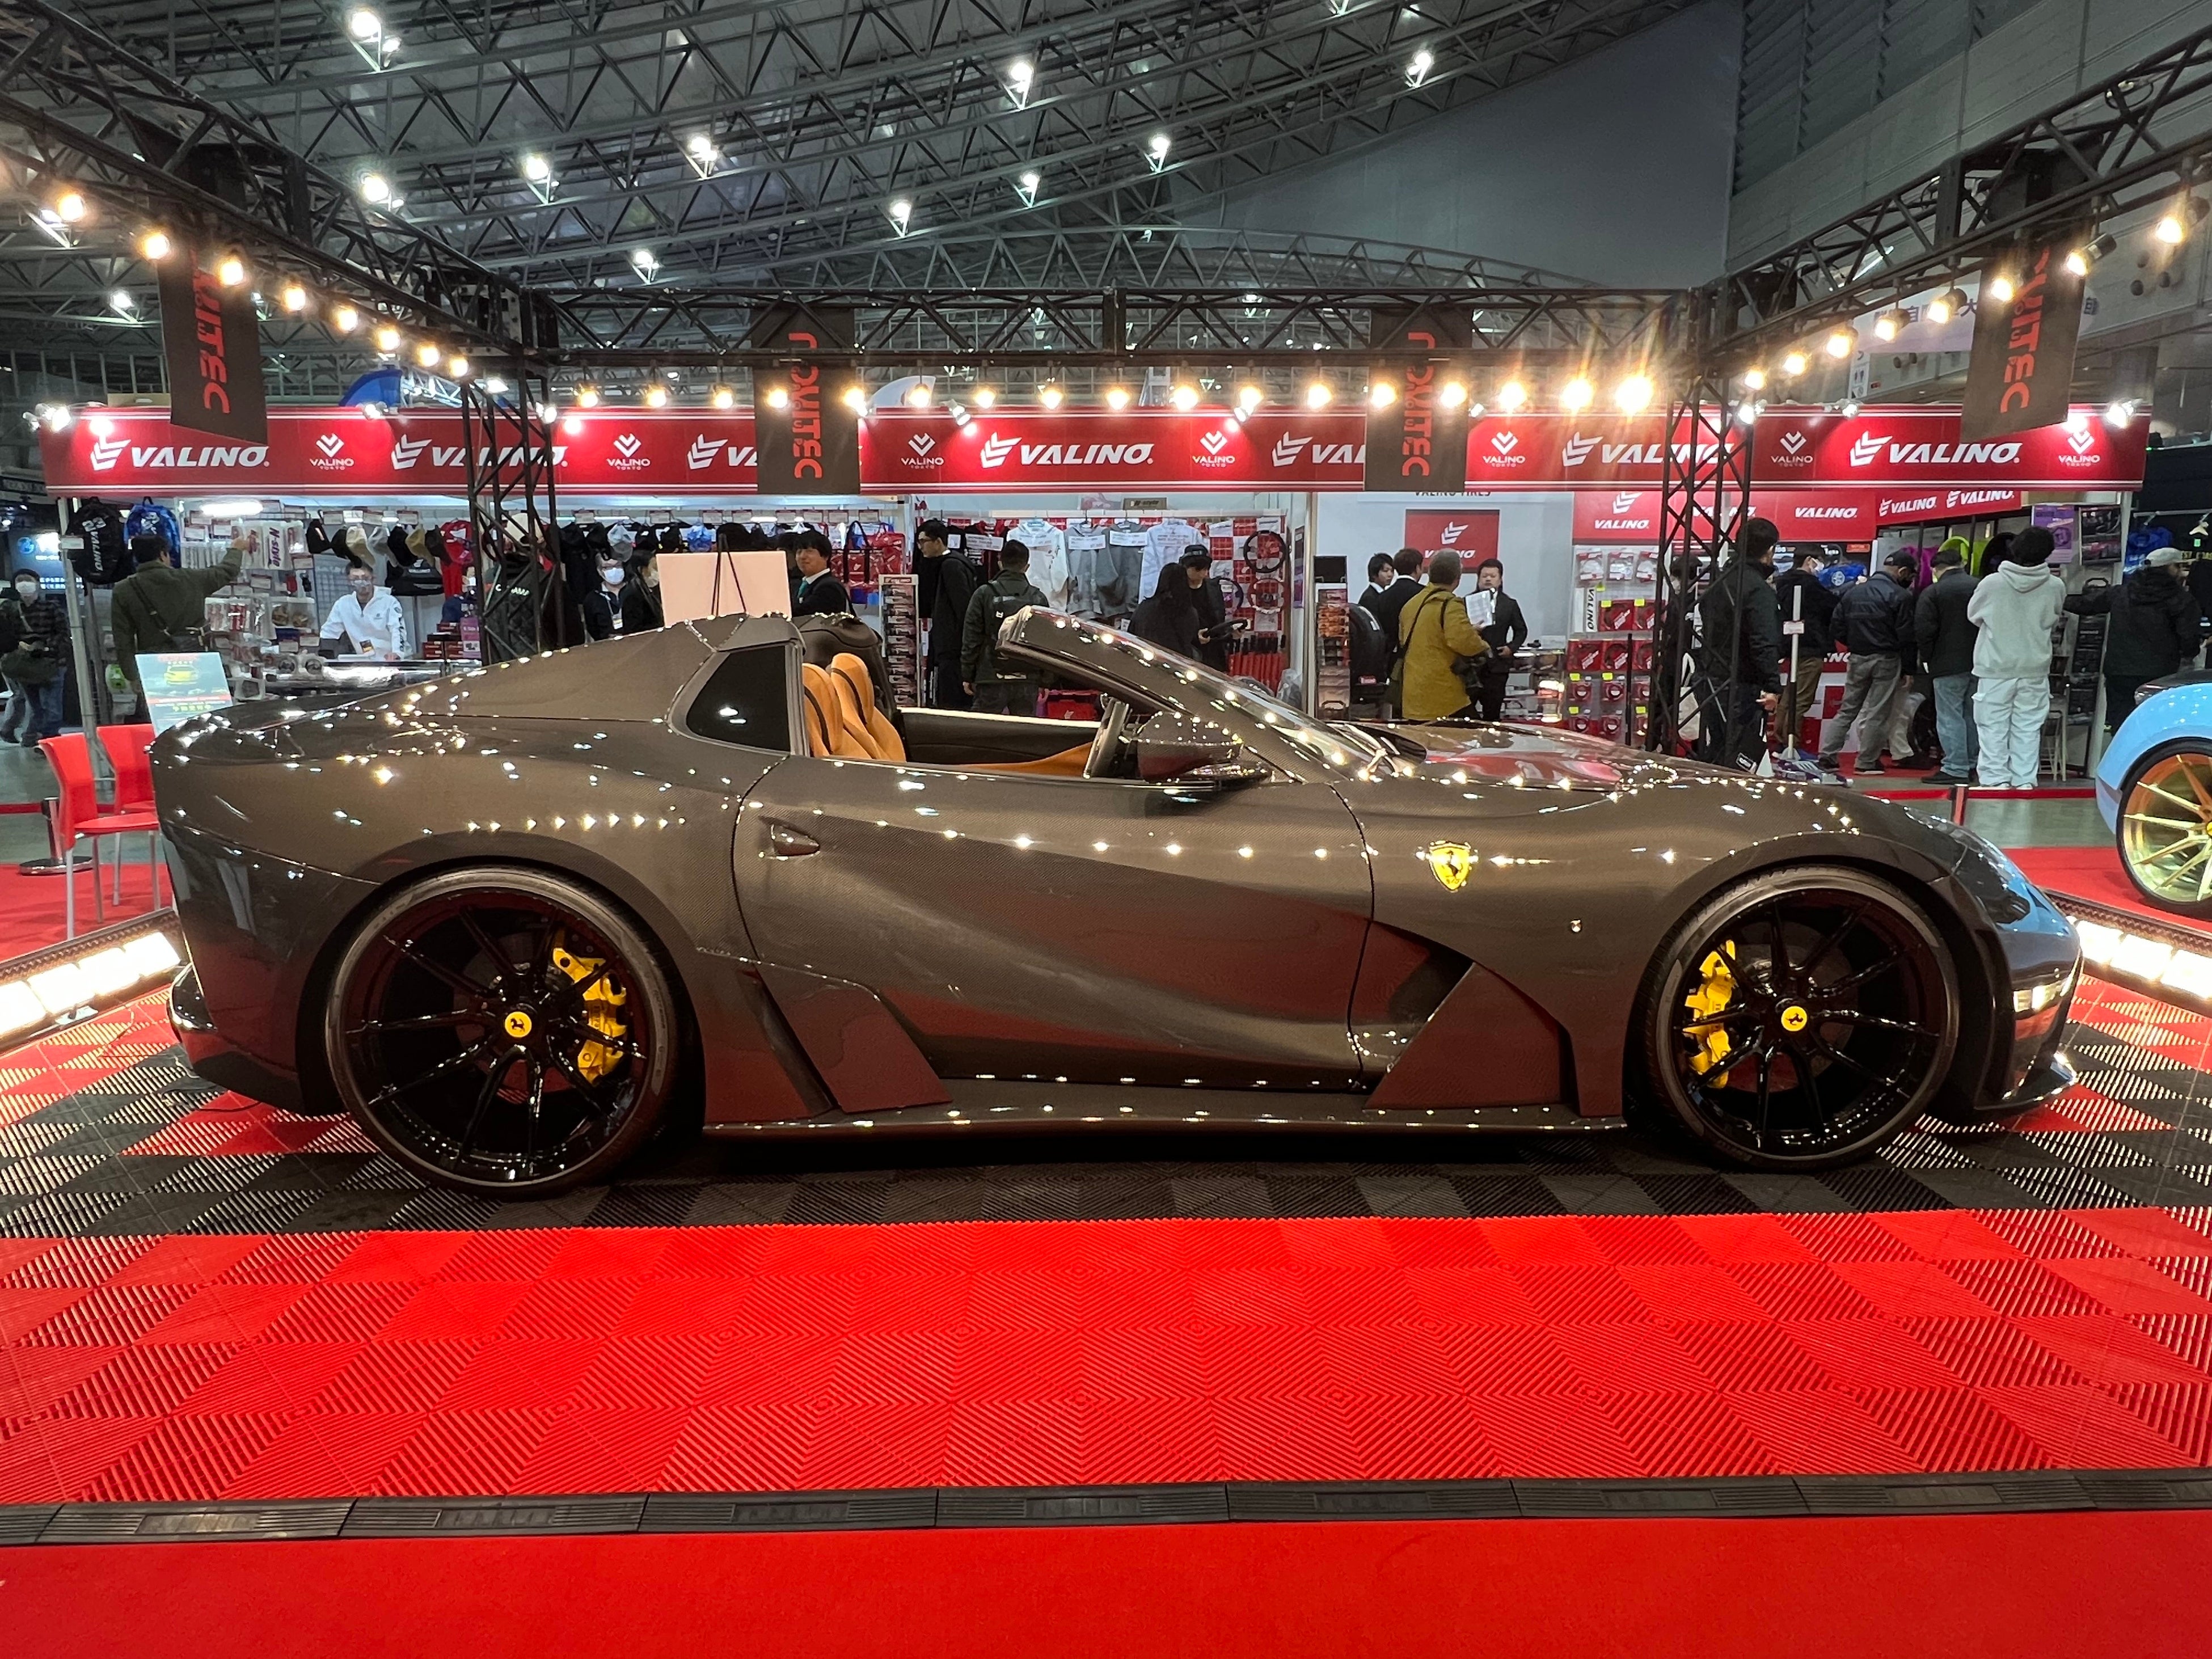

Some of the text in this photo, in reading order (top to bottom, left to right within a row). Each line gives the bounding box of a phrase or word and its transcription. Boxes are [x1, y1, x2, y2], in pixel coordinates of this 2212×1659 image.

[131, 446, 269, 467] VALINO
[1020, 443, 1155, 465] VALINO
[1889, 442, 2022, 464] VALINO
[1795, 507, 1858, 518] VALINO
[1891, 496, 1937, 513] VALINO
[1594, 520, 1649, 529] VALINO
[90, 531, 103, 571] VALINO
